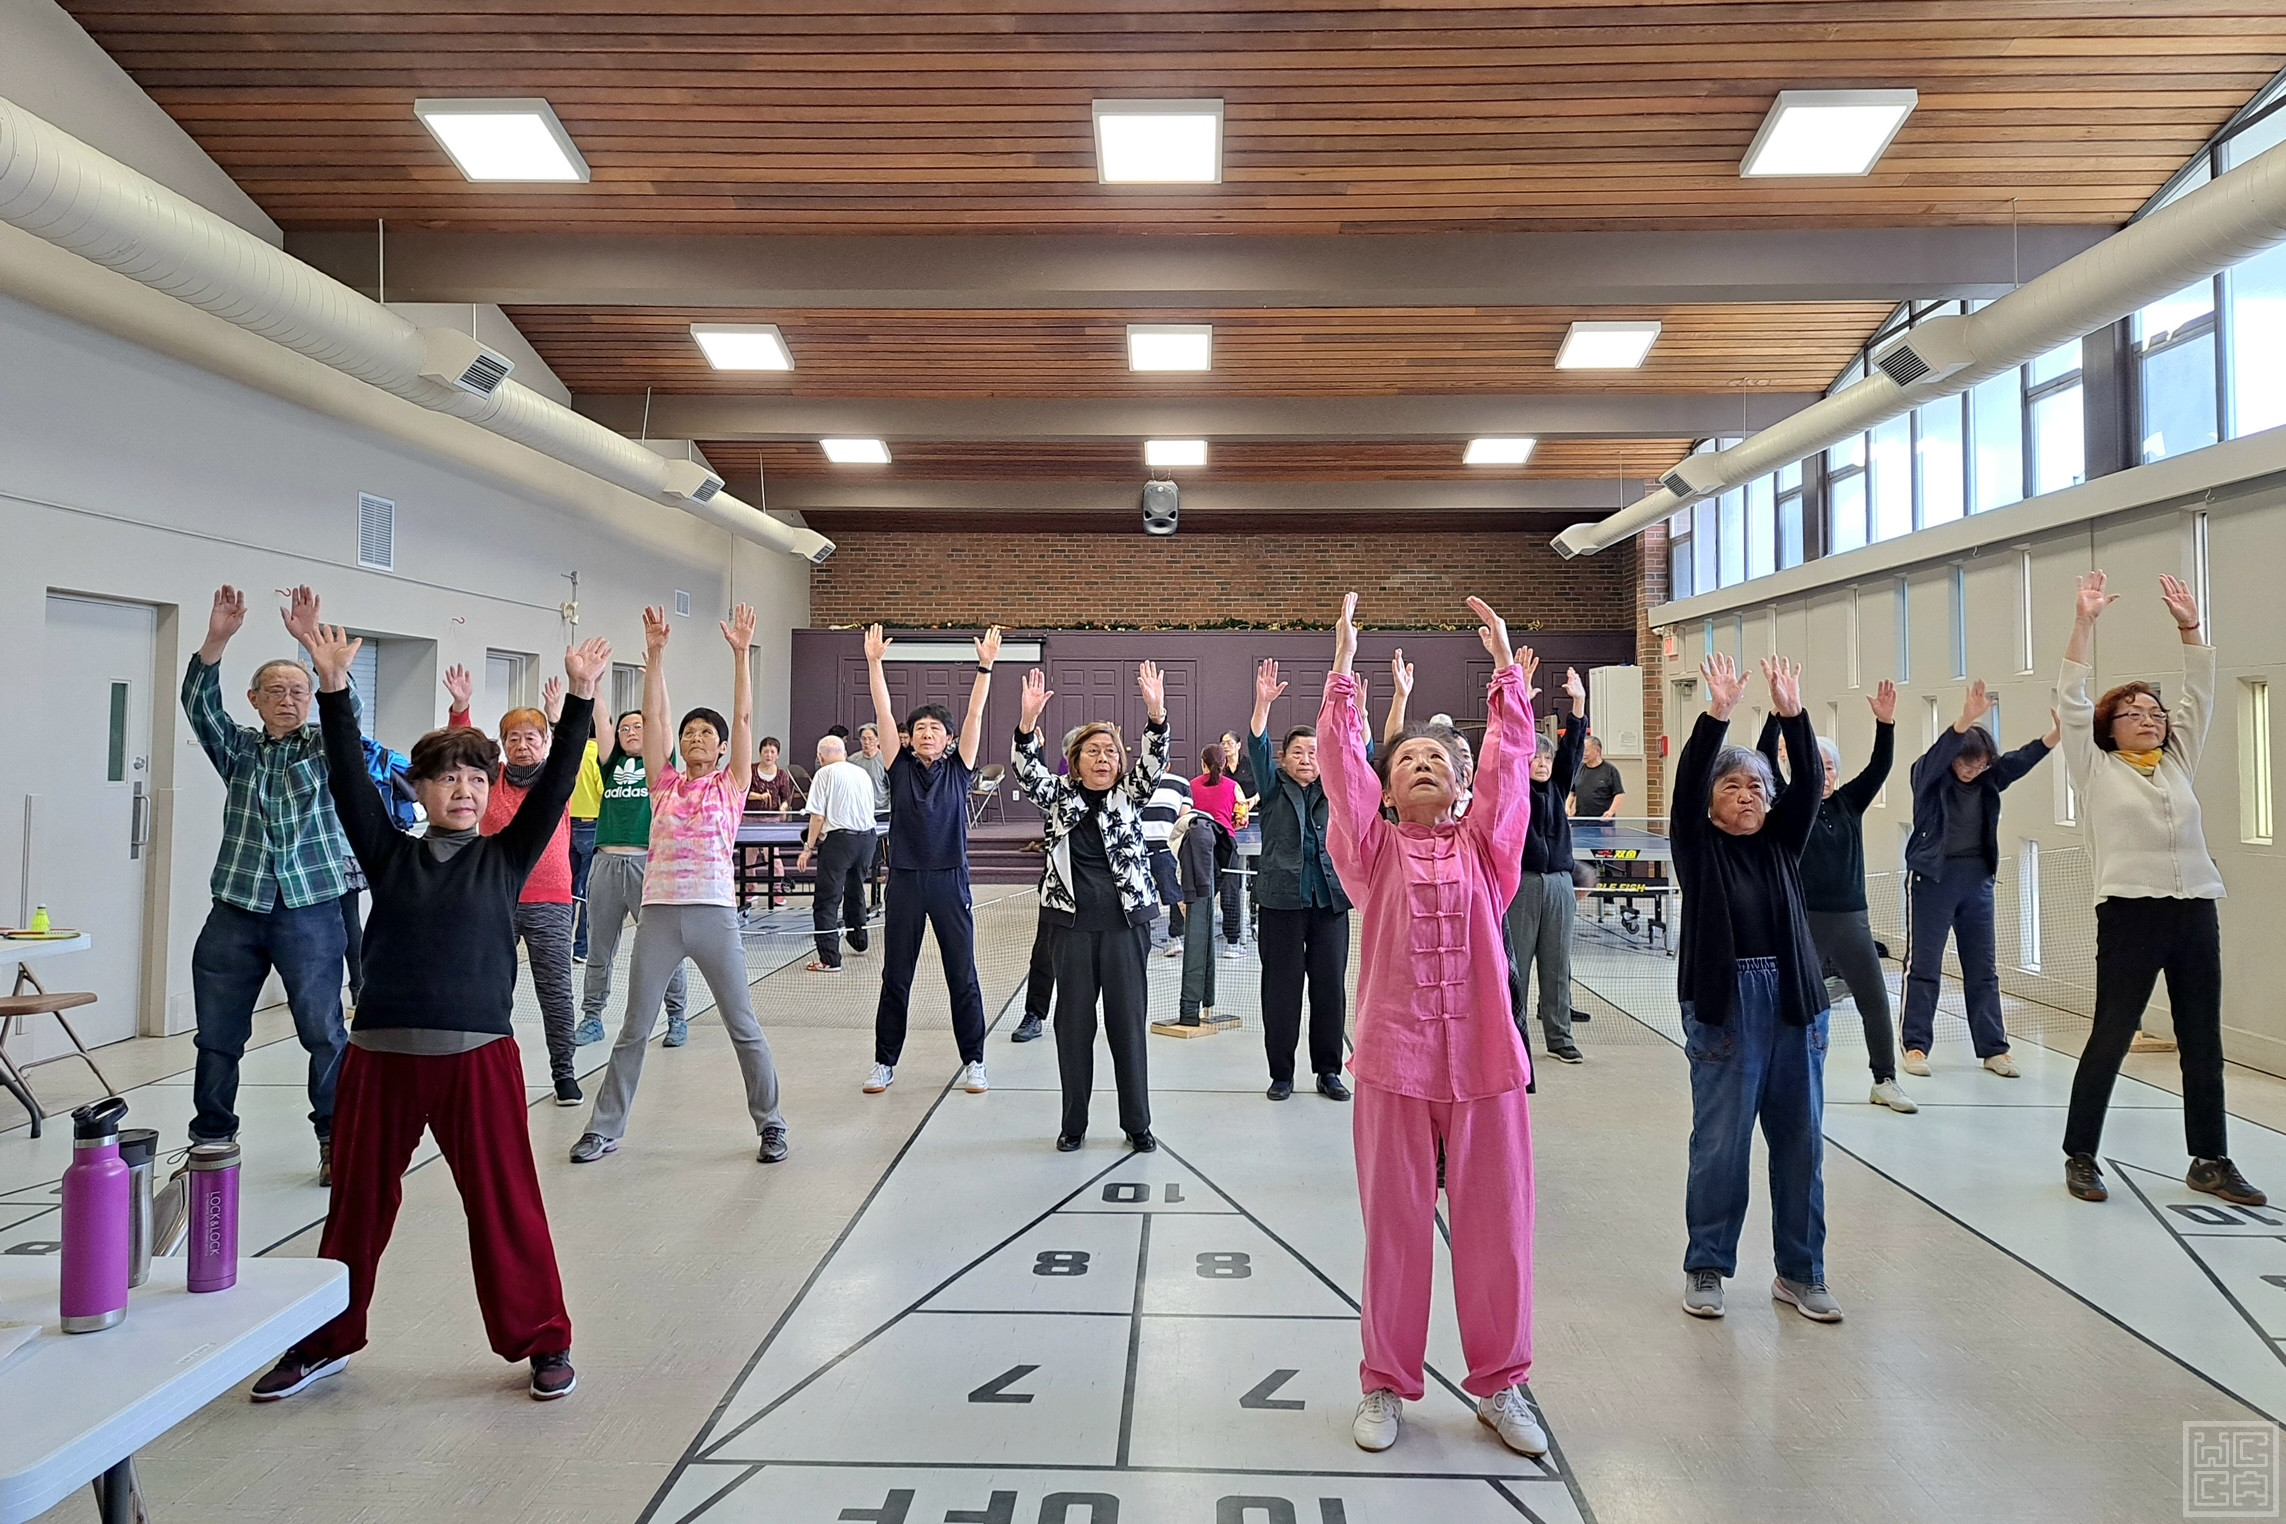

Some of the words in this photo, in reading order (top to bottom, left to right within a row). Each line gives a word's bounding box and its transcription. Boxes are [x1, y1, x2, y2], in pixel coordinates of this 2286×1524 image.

[604, 786, 649, 798] adidas
[1102, 1183, 1186, 1204] 10
[210, 1191, 221, 1257] LOCK&LOCK
[1032, 1250, 1091, 1277] 8
[1195, 1251, 1252, 1280] 8
[967, 1364, 1042, 1404] 7
[1238, 1368, 1306, 1411] 7
